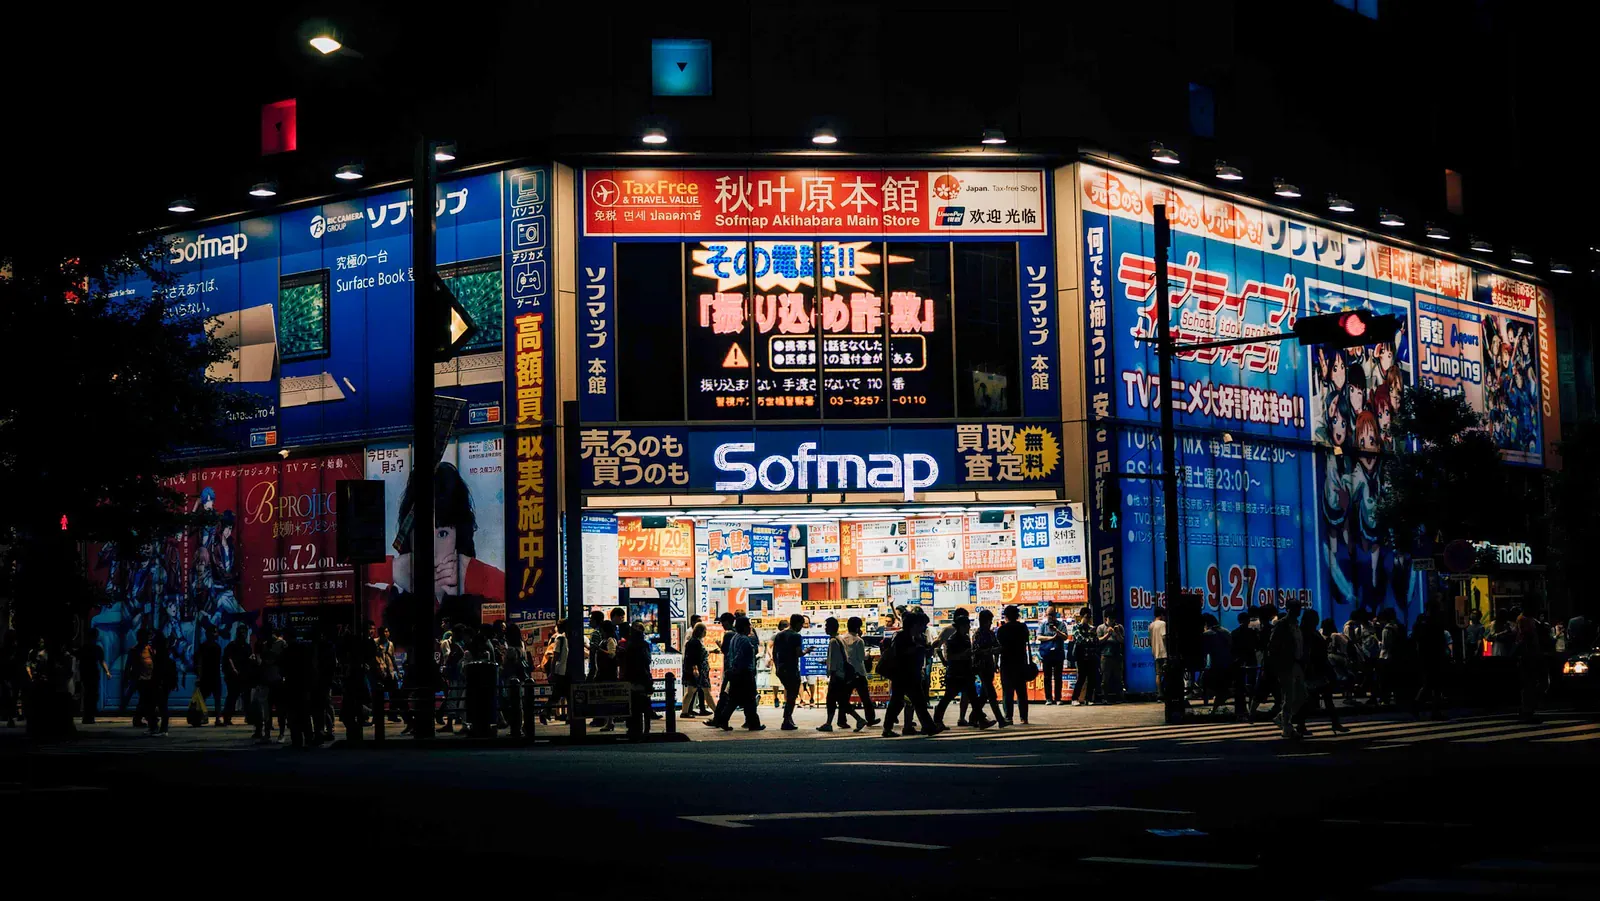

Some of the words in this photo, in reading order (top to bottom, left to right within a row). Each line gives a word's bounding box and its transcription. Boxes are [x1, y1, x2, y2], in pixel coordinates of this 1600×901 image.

[632, 196, 667, 204] TRAVEL
[670, 196, 699, 204] VALUE
[714, 175, 920, 214] 秋叶原本館
[965, 185, 990, 193] Japan.
[1020, 185, 1038, 193] Shop
[512, 204, 544, 217] パソコン
[594, 210, 617, 221] 免税
[624, 210, 646, 221] 면세
[715, 214, 769, 228] Sofmap
[772, 214, 842, 226] Akihabara
[846, 214, 879, 226] Main
[883, 214, 920, 227] Store
[327, 223, 347, 232] GROUP
[169, 232, 248, 265] Sofmap
[336, 249, 388, 271] 究極の一台
[512, 251, 544, 263] デジカメ
[336, 276, 375, 293] Surface
[378, 270, 405, 285] Book
[516, 297, 540, 308] ゲーム
[585, 266, 608, 348] ソフマップ
[1026, 265, 1050, 346] ソフマップ
[1087, 226, 1107, 385] 何でも揃う!!
[1182, 312, 1216, 331] School
[1418, 315, 1445, 347] 青空
[1420, 346, 1482, 385] Jumping
[1536, 287, 1552, 418] KANBUNDO
[588, 357, 607, 394] 本館
[1031, 354, 1050, 391] 本館
[580, 429, 684, 459] 売るのも
[956, 424, 1016, 453] 買取
[1024, 432, 1045, 473] 無料
[592, 457, 690, 486] 買うのも
[713, 441, 939, 502] Sofmap
[964, 453, 1024, 482] 査定
[1022, 515, 1049, 531] 欢迎
[1022, 531, 1049, 547] 使用
[942, 581, 968, 592] SoftB
[1129, 586, 1167, 609] Blu-ra
[1205, 563, 1258, 612] 9.27
[1257, 587, 1275, 607] ON
[522, 610, 537, 620] Tax
[538, 609, 557, 620] Free
